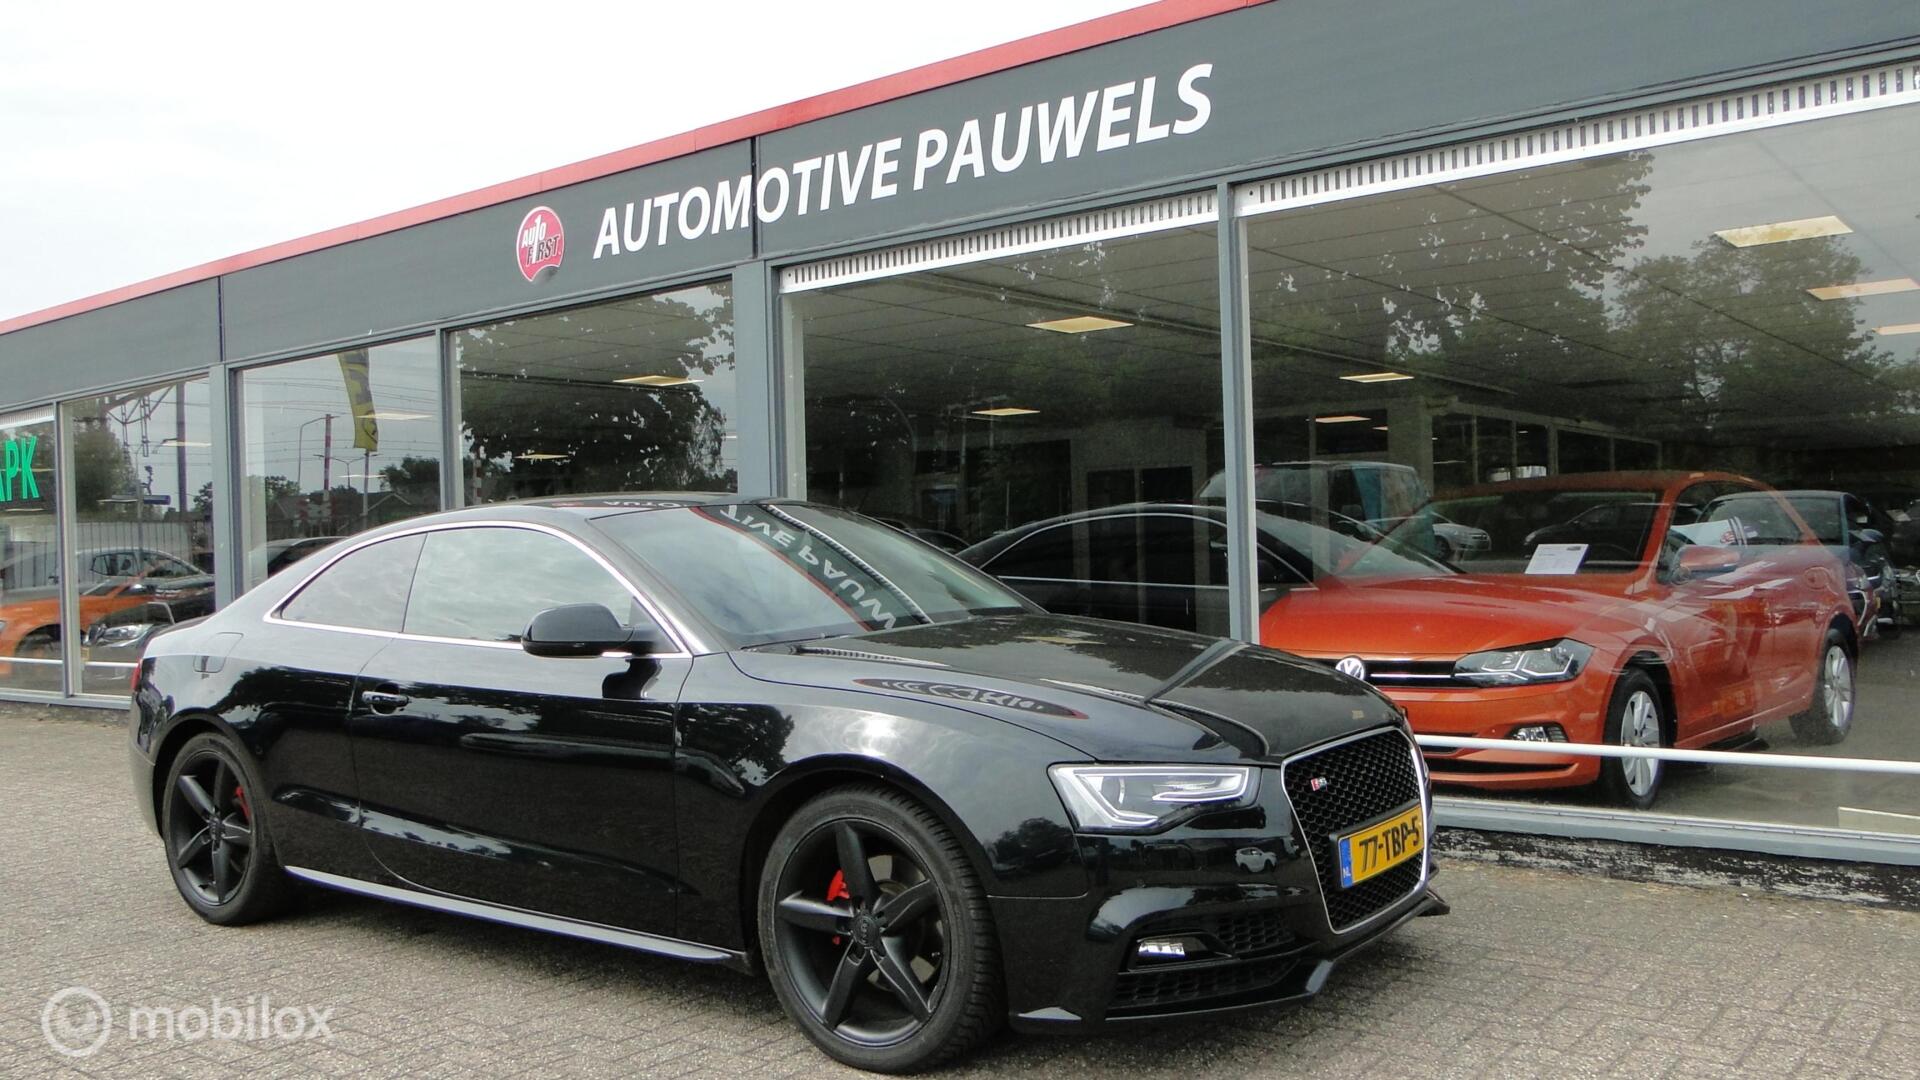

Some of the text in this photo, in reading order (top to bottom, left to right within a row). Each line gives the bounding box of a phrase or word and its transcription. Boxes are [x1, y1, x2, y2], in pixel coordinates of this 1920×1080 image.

[592, 63, 1214, 260] AUTOMOTIVE PAUWELS
[0, 435, 40, 502] PK
[1358, 815, 1420, 873] 77-TBP-5
